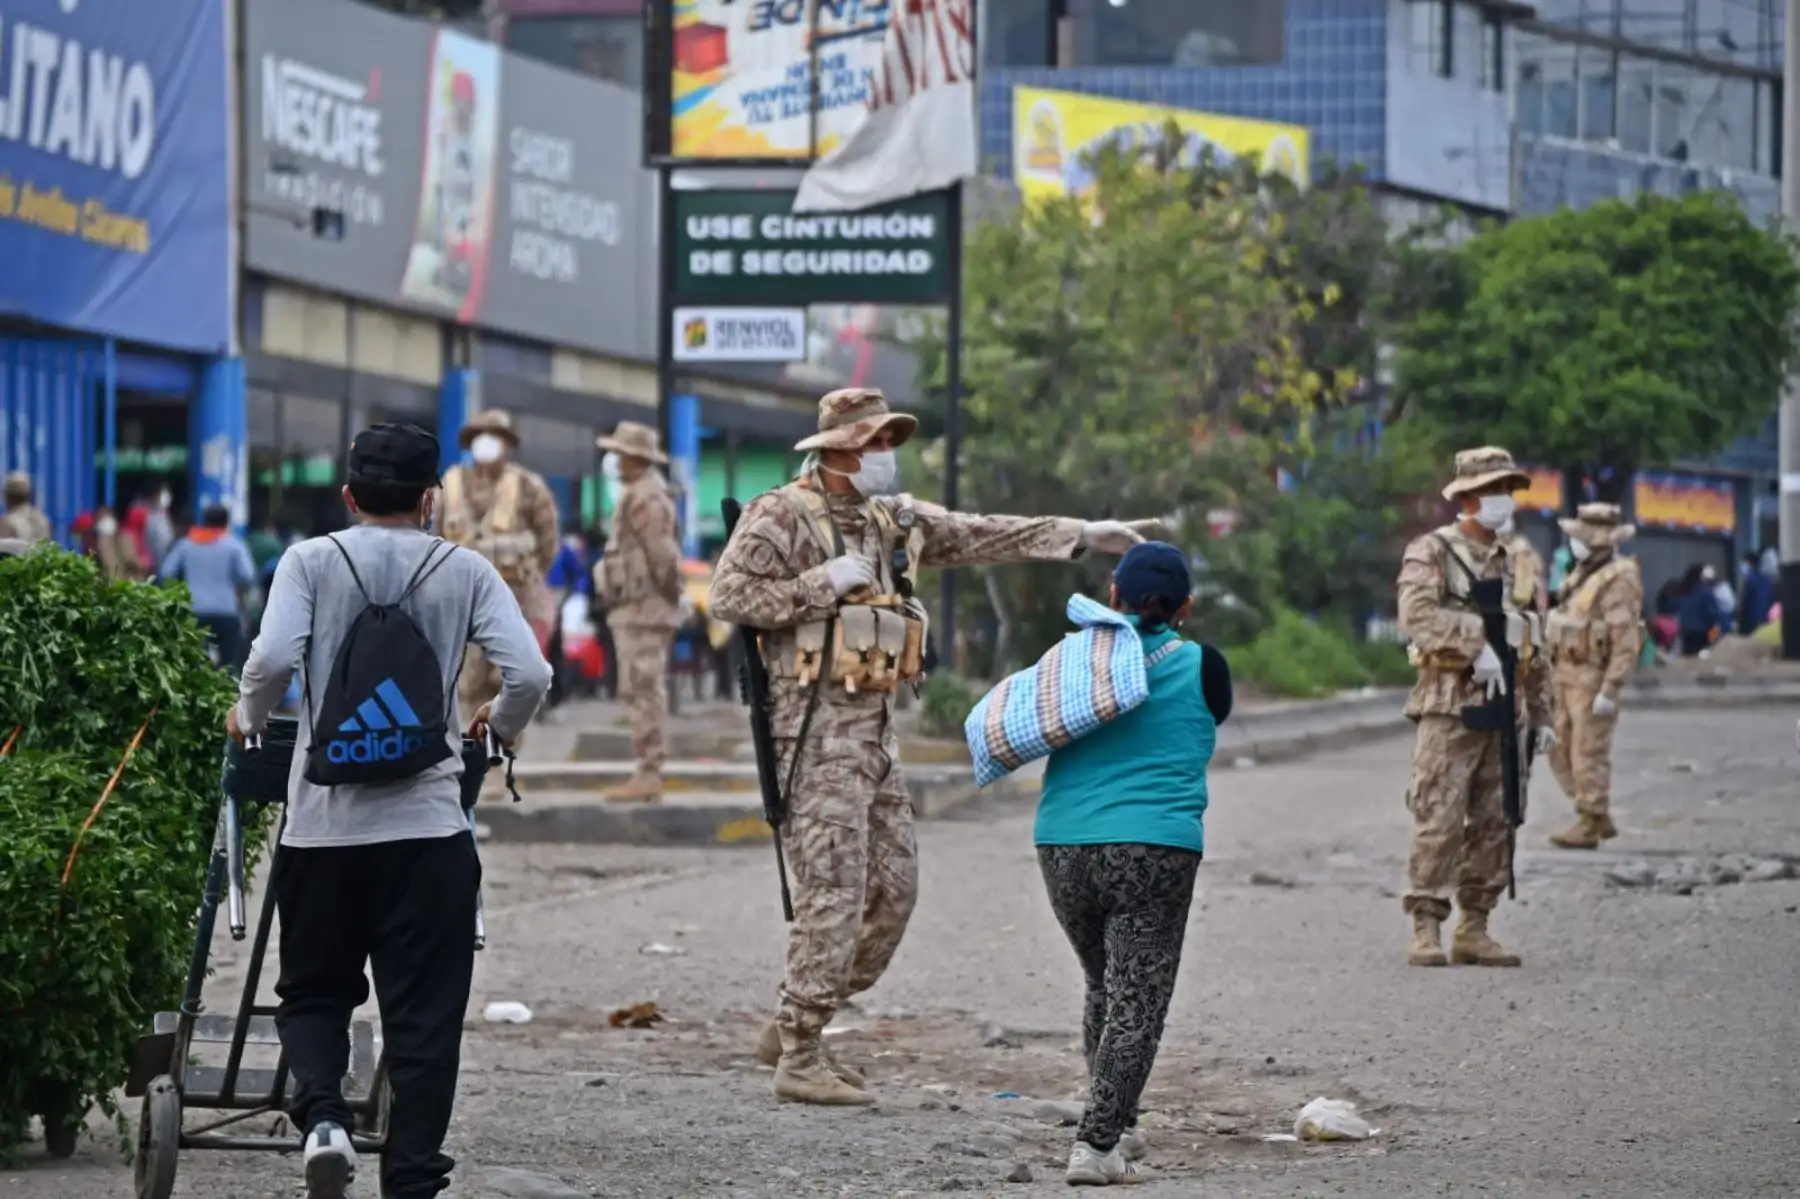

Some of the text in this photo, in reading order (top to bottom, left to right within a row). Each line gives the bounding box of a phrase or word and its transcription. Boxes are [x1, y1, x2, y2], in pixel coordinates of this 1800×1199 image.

[0, 22, 154, 179] ITANO
[687, 212, 935, 239] USE CINTURÓN
[689, 250, 932, 275] DE SEGURIDAD
[326, 729, 421, 764] adida
